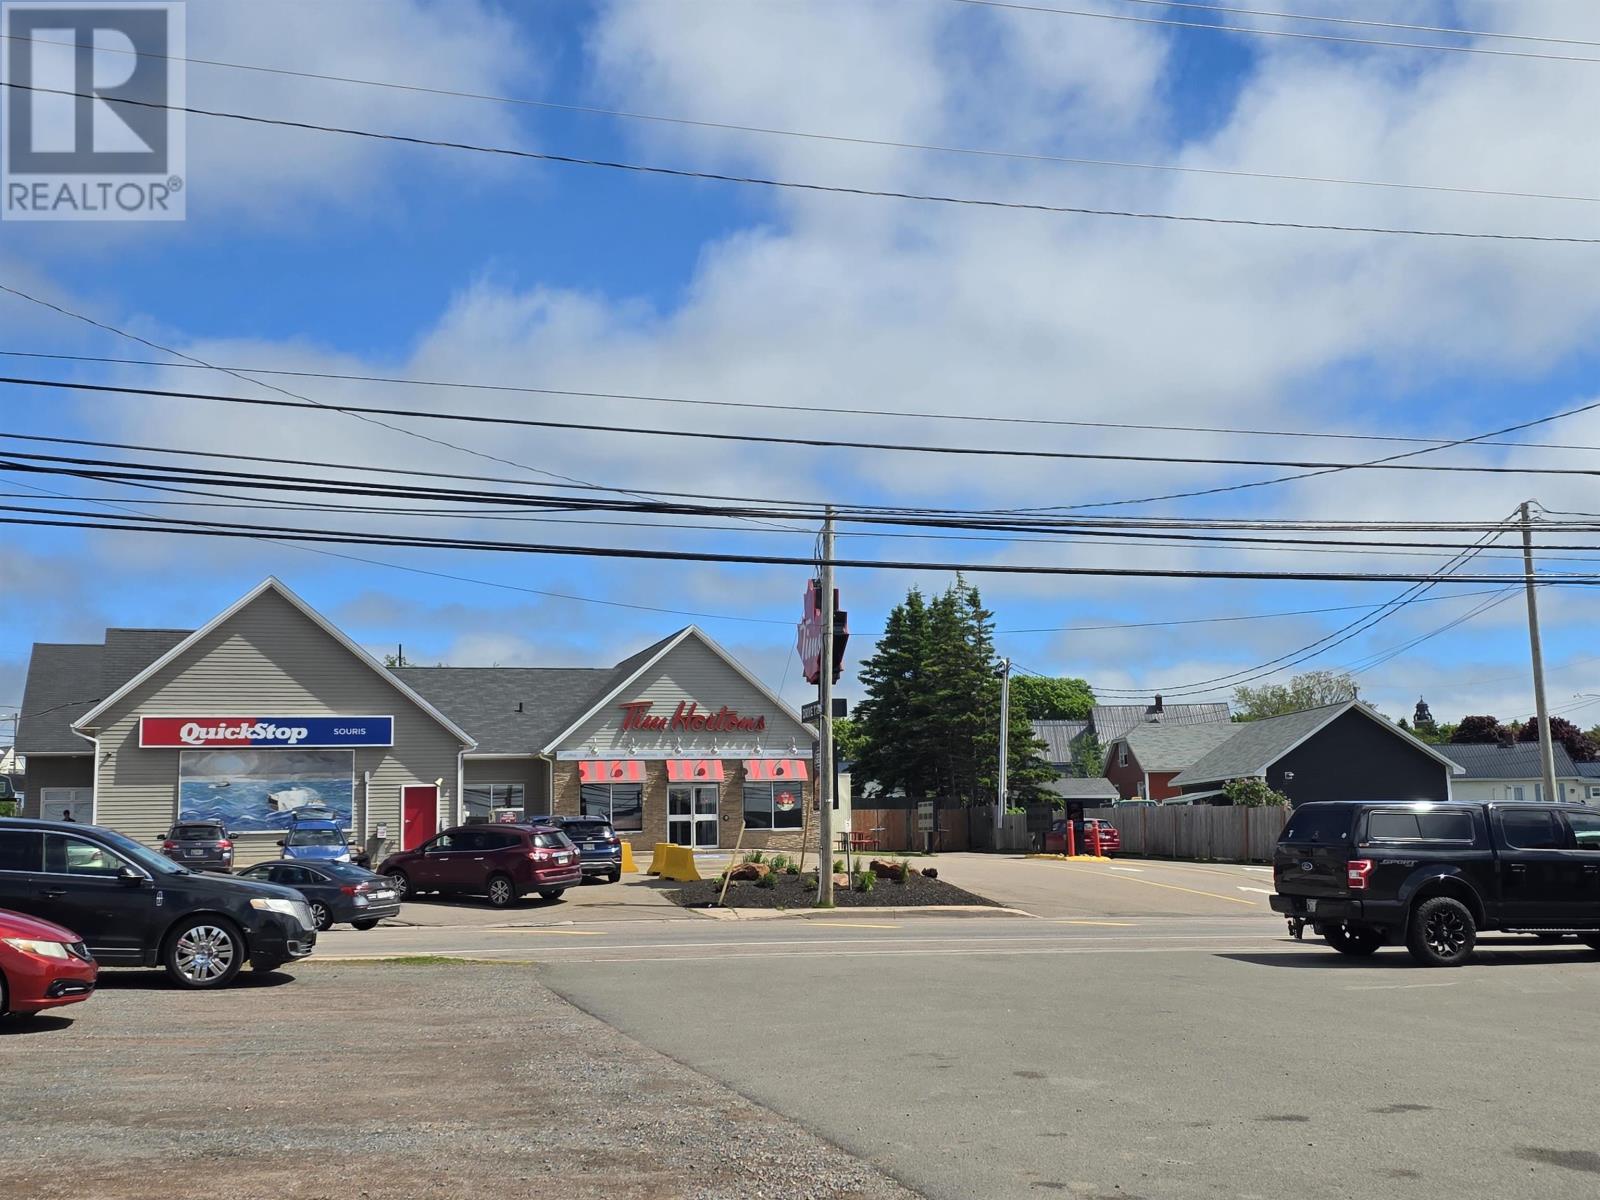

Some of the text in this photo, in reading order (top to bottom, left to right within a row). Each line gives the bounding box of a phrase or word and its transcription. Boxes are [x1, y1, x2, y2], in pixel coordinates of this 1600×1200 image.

[618, 700, 766, 732] Tim Hortons
[179, 722, 308, 744] QuickStop
